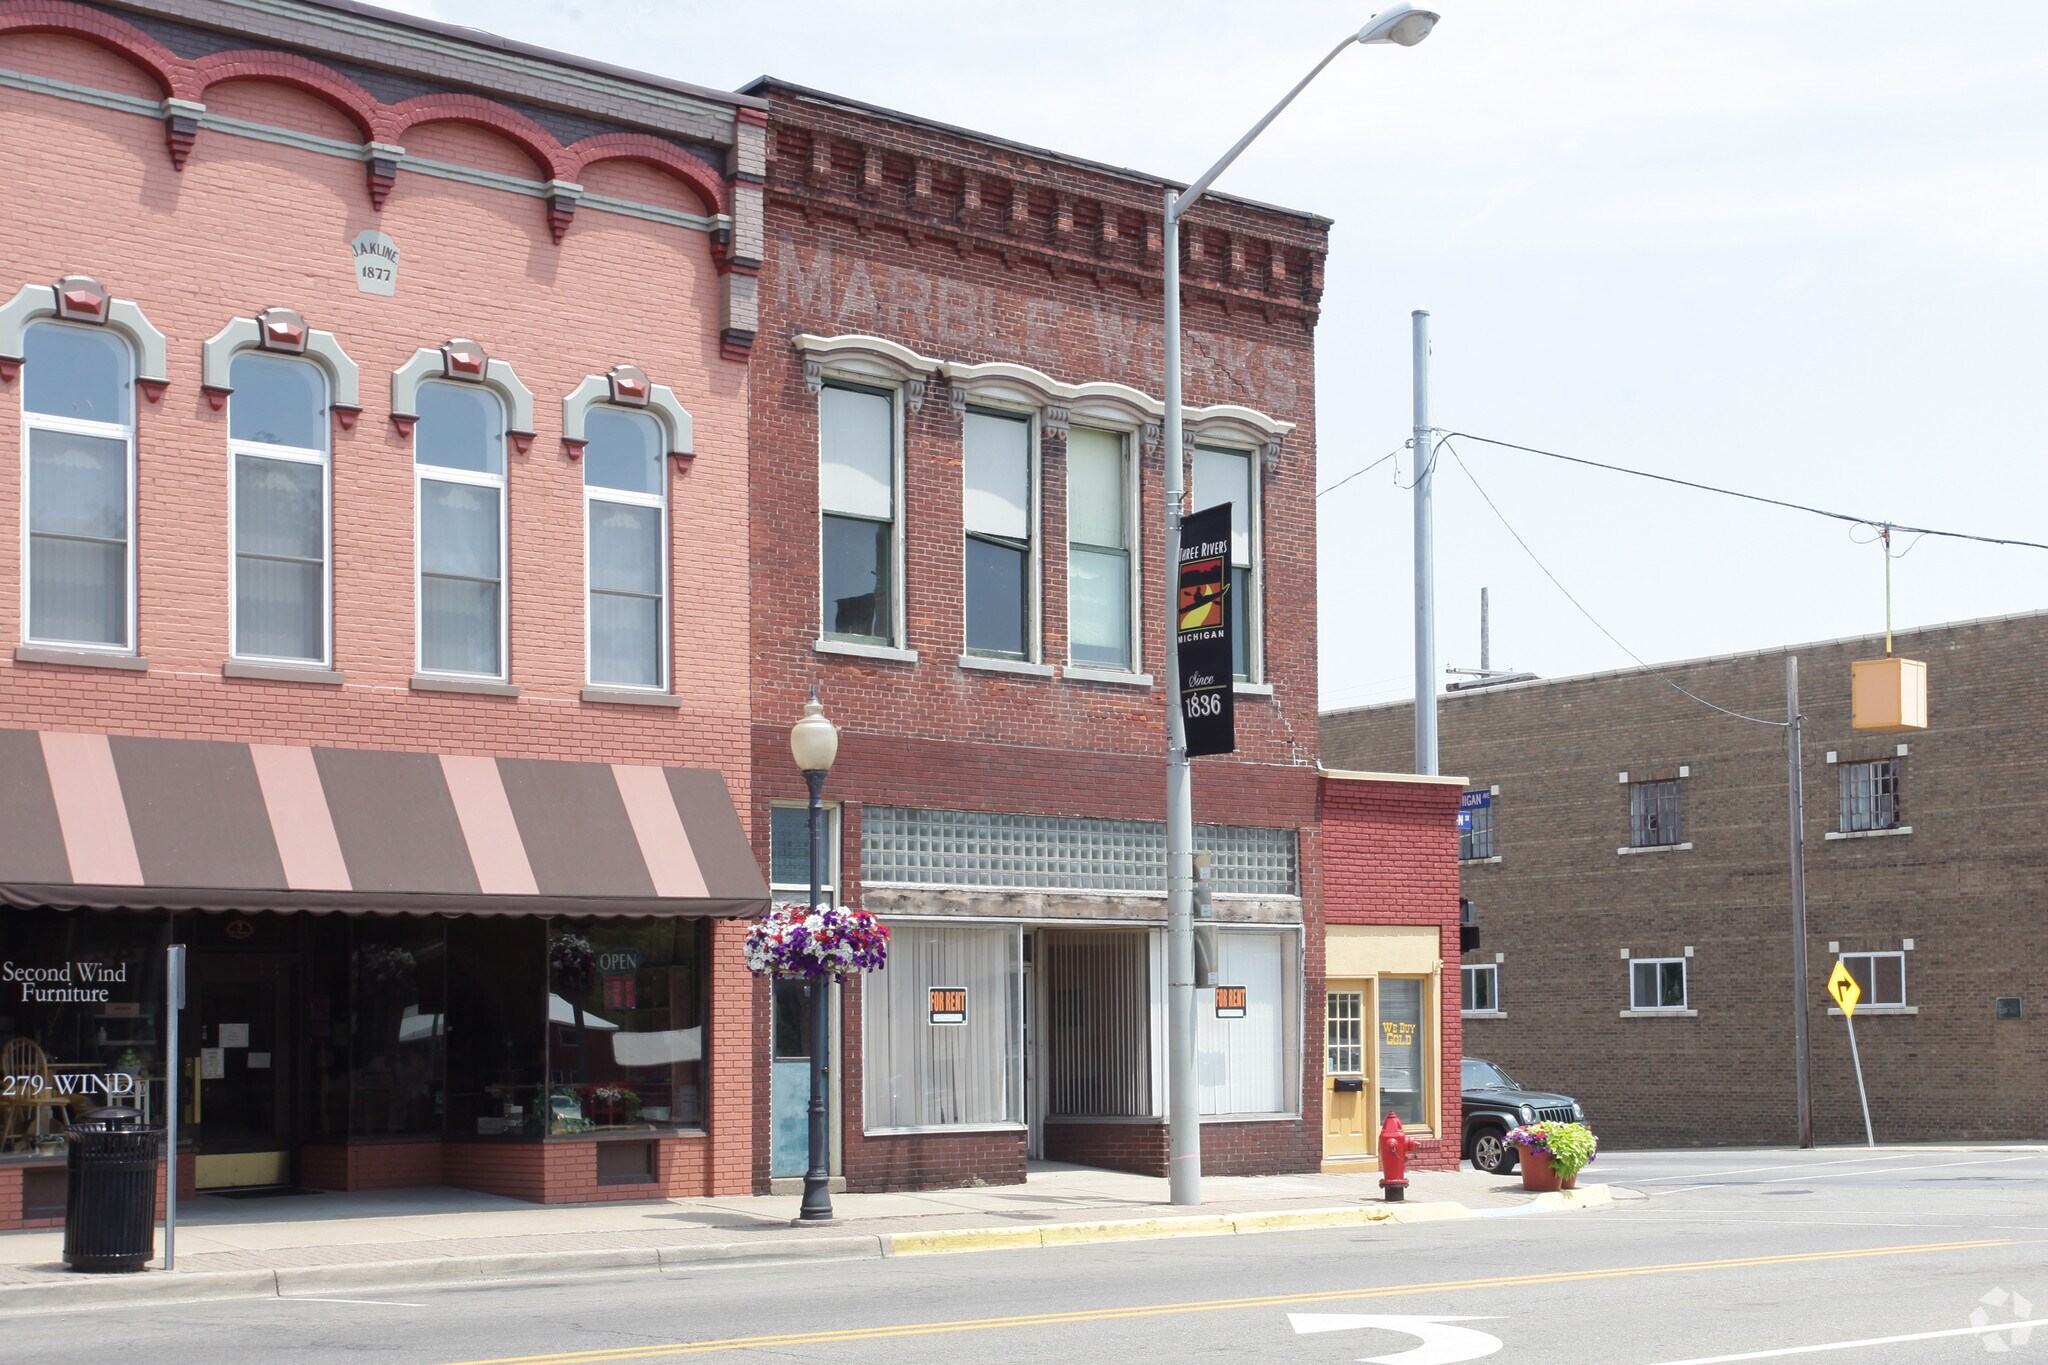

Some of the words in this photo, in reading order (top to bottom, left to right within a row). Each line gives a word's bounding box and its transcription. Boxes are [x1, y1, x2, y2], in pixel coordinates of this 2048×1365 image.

[362, 266, 391, 281] 1877
[777, 234, 1065, 363] MARBLE
[1179, 546, 1199, 561] THREE
[1201, 540, 1228, 557] RIVERS
[1178, 630, 1224, 644] MICHIGAN
[1188, 671, 1215, 688] Since
[1185, 692, 1221, 718] 1836
[2, 961, 71, 982] Second
[76, 961, 127, 982] Wind
[600, 953, 637, 970] OPEN
[21, 982, 109, 1002] Furniture
[930, 991, 944, 1012] FOR
[945, 991, 965, 1012] RENT
[1216, 988, 1228, 1008] FOR
[1228, 988, 1246, 1008] RENT
[2, 1072, 134, 1096] 279-WIND
